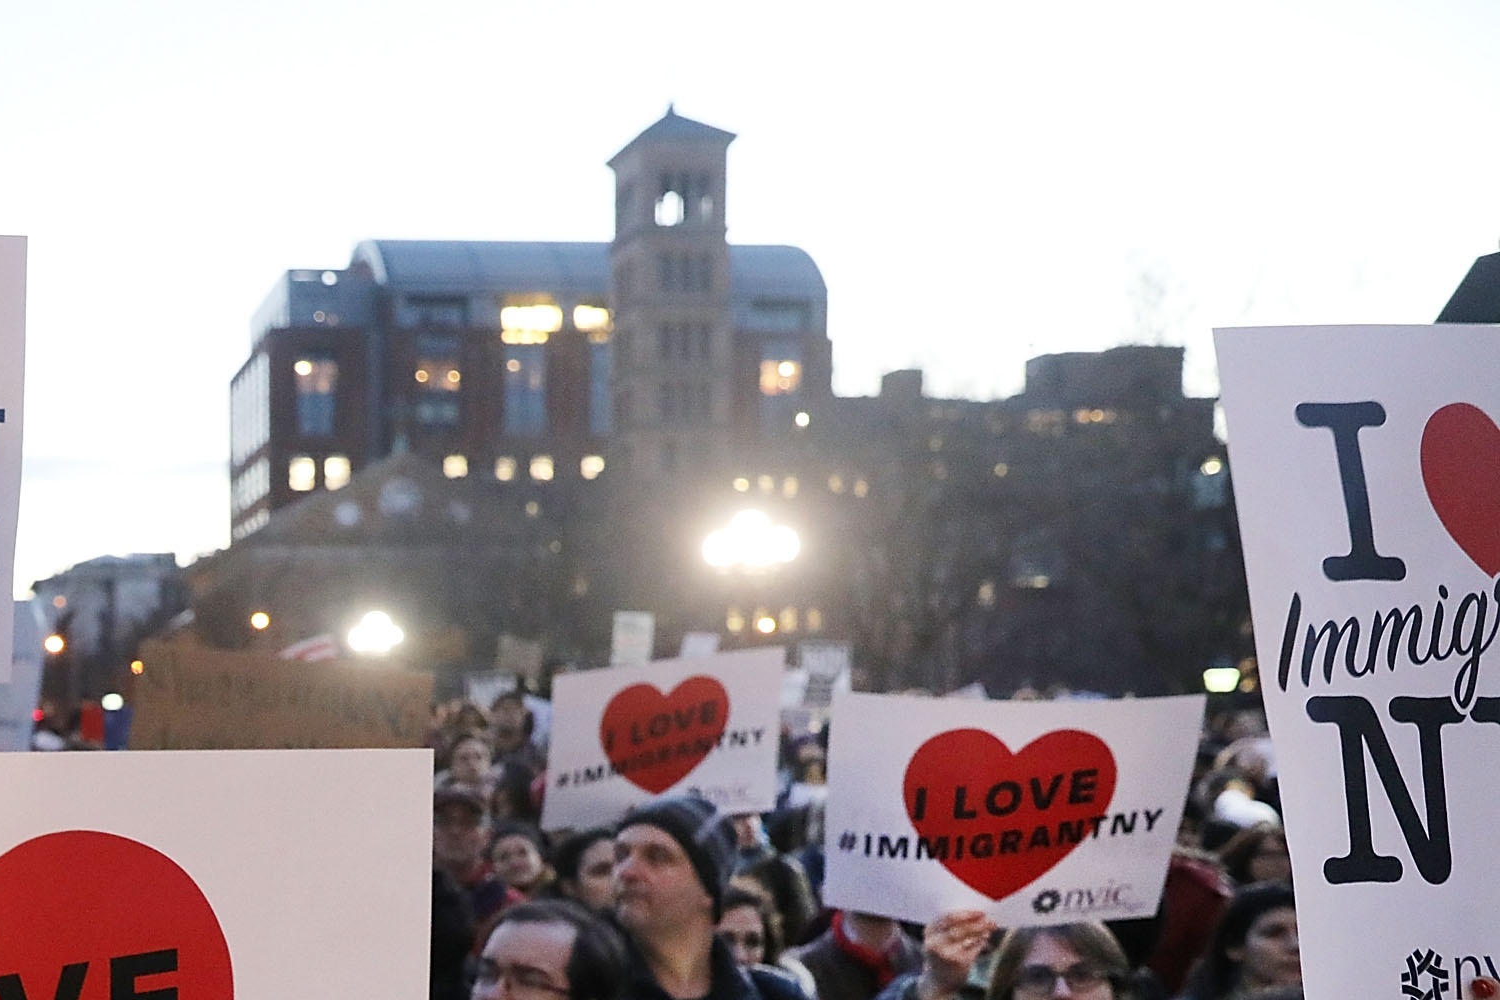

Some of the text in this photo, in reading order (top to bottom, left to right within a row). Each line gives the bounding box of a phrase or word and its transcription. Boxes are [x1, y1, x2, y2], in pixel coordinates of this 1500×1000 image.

[1295, 401, 1407, 582] I
[1277, 583, 1500, 709] Immig
[629, 701, 719, 746] LOVE
[838, 808, 1163, 861] #IMMIGRANTNY
[913, 768, 1099, 822] I LOVE
[1306, 695, 1500, 885] N
